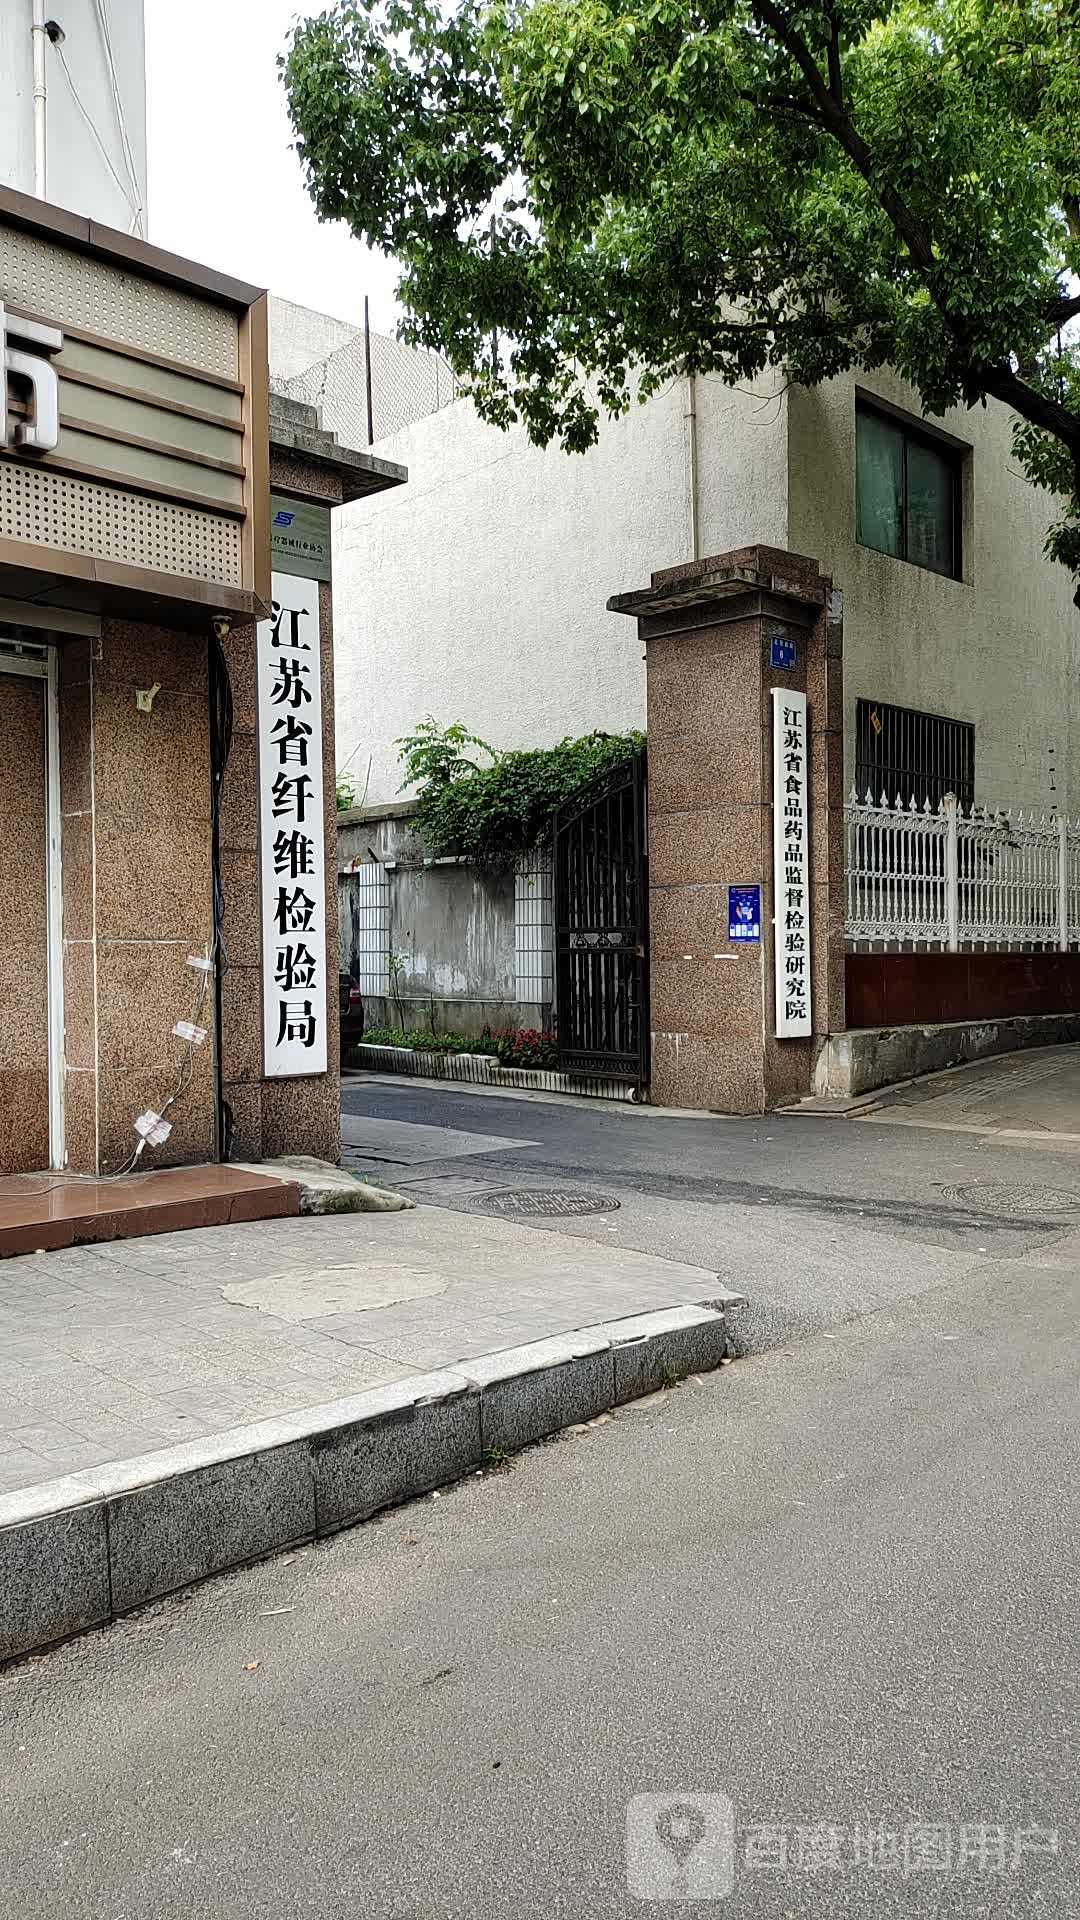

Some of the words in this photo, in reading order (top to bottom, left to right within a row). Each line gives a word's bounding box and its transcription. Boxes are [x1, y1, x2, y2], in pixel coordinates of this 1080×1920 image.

[269, 600, 317, 1048] 江苏省纤维检验局
[783, 706, 807, 1020] 江苏省食品药品监督检验研究院
